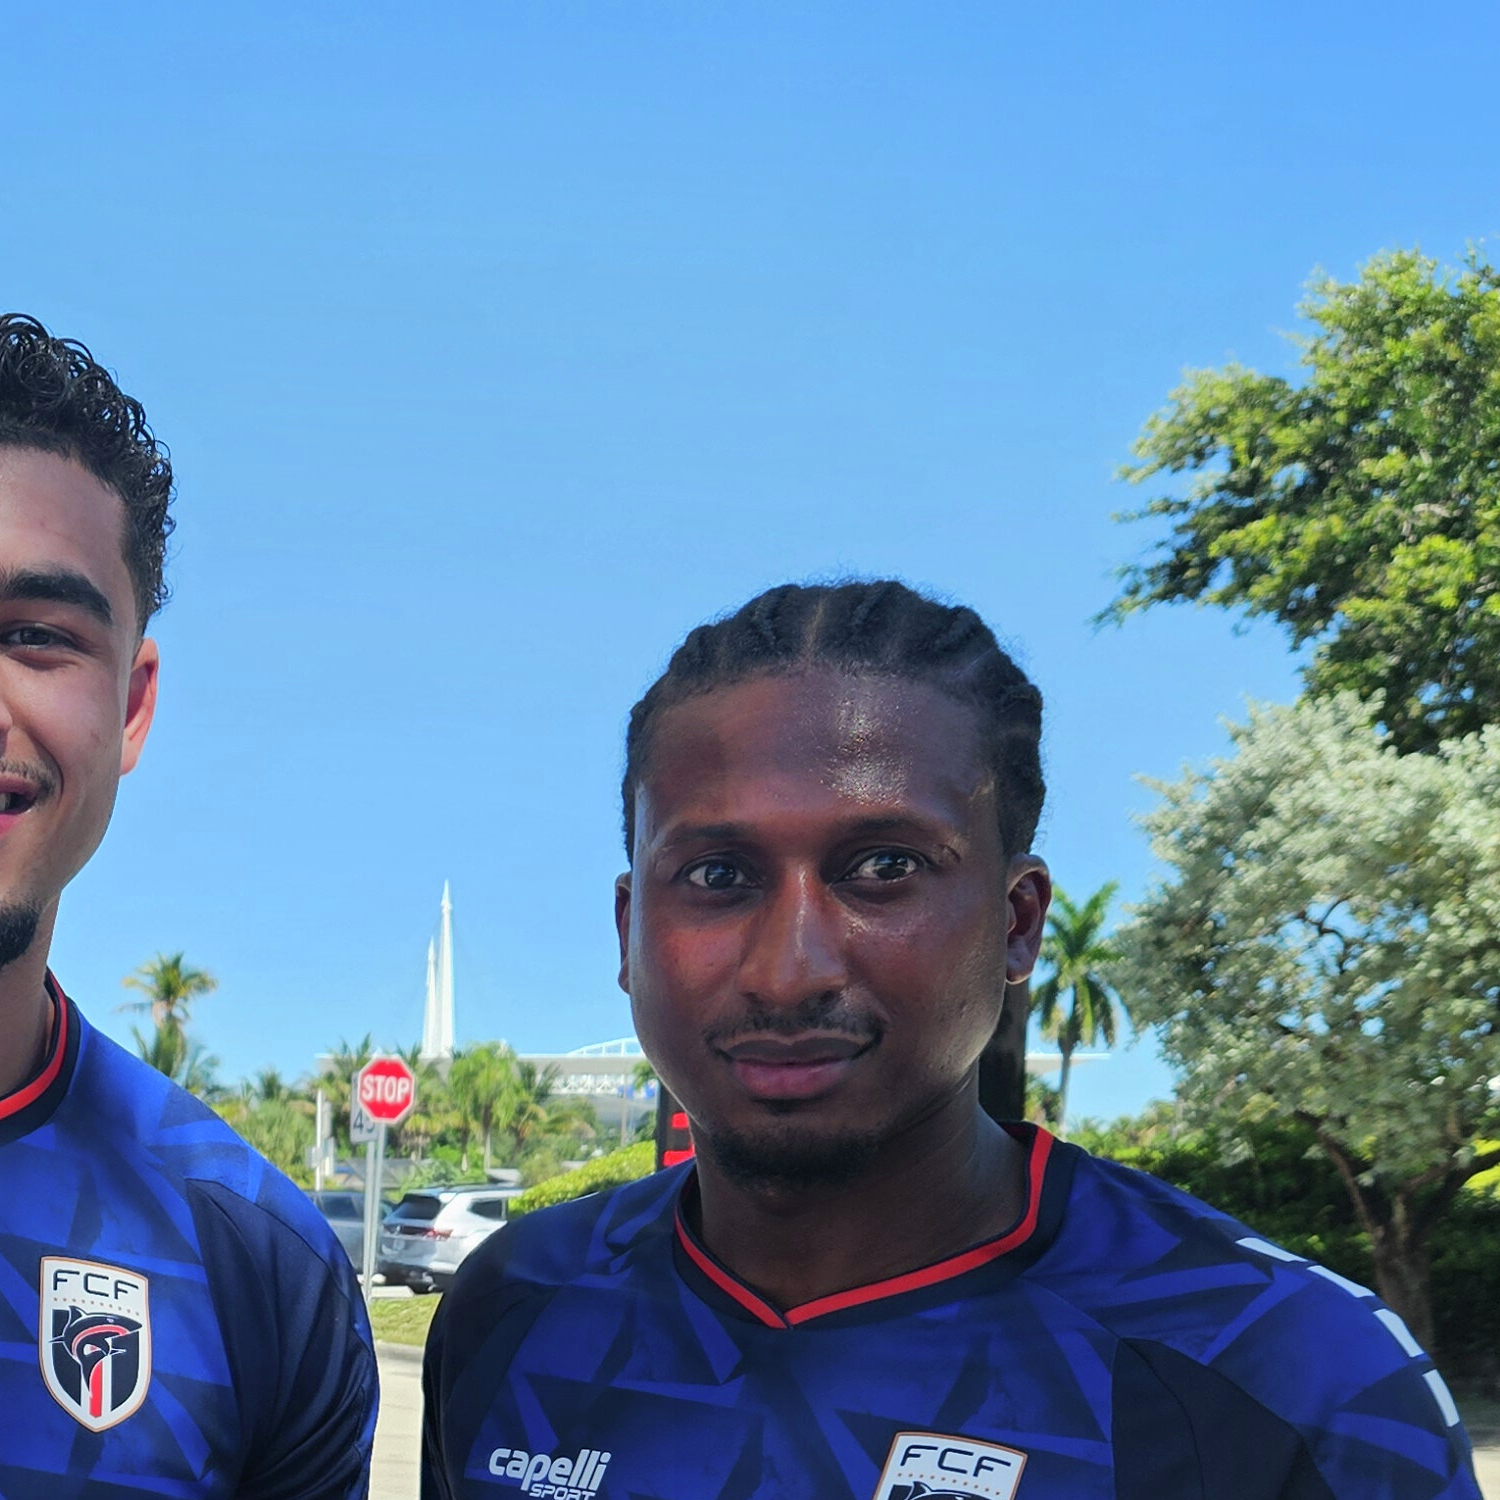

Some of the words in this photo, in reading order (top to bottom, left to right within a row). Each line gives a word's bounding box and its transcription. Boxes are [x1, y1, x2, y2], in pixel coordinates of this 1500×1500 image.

[362, 1073, 411, 1105] STOP
[53, 1269, 140, 1300] FCF
[488, 1448, 612, 1492] capelli
[899, 1444, 1012, 1478] FCF
